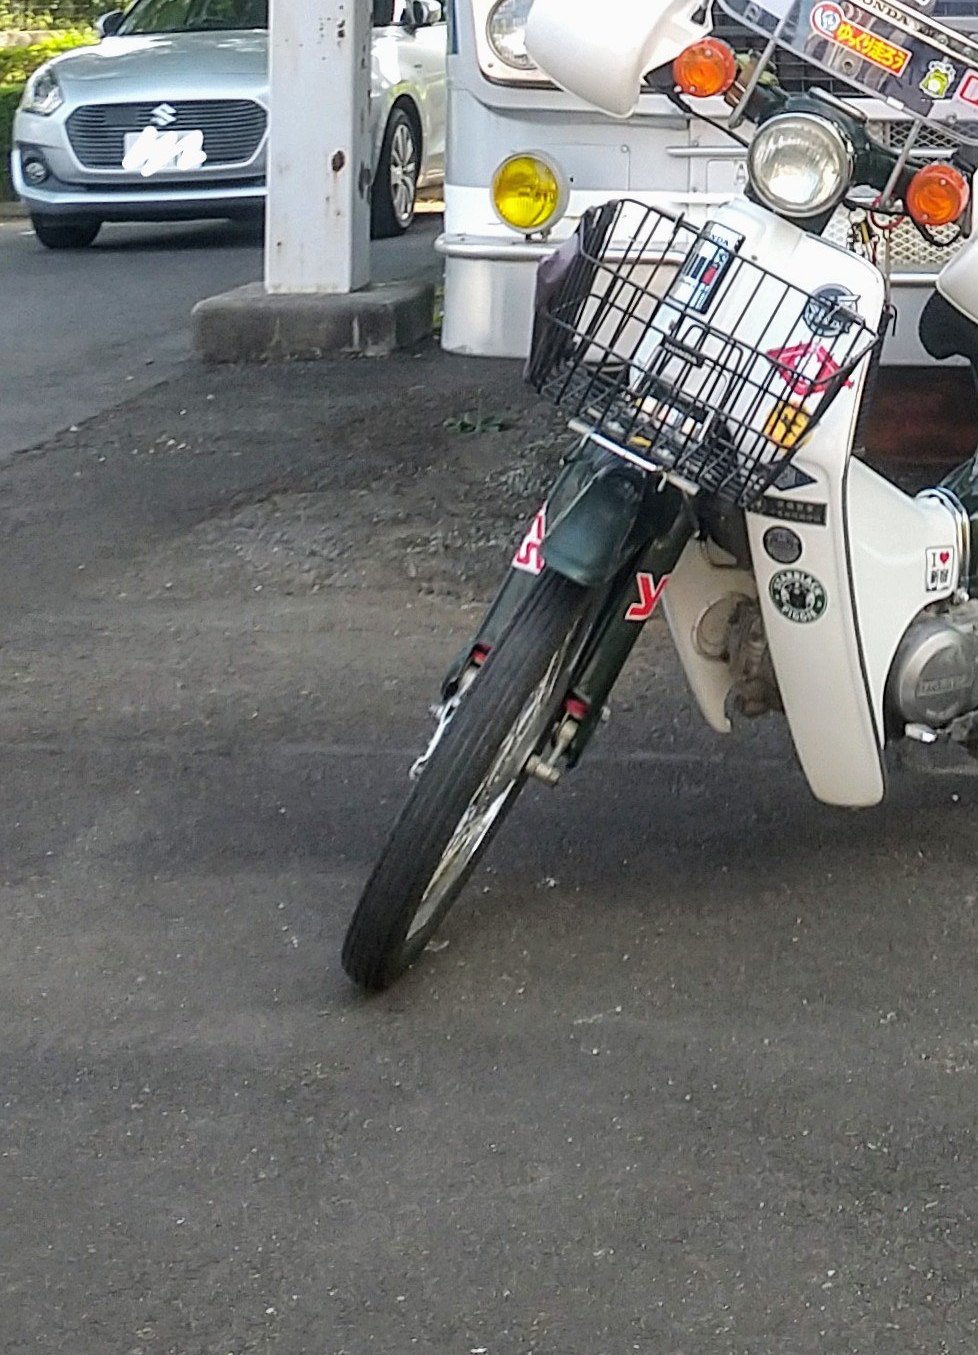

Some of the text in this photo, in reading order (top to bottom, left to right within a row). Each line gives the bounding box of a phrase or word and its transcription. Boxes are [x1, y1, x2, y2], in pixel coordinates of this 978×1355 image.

[836, 23, 906, 70] ゆっくり走ろう
